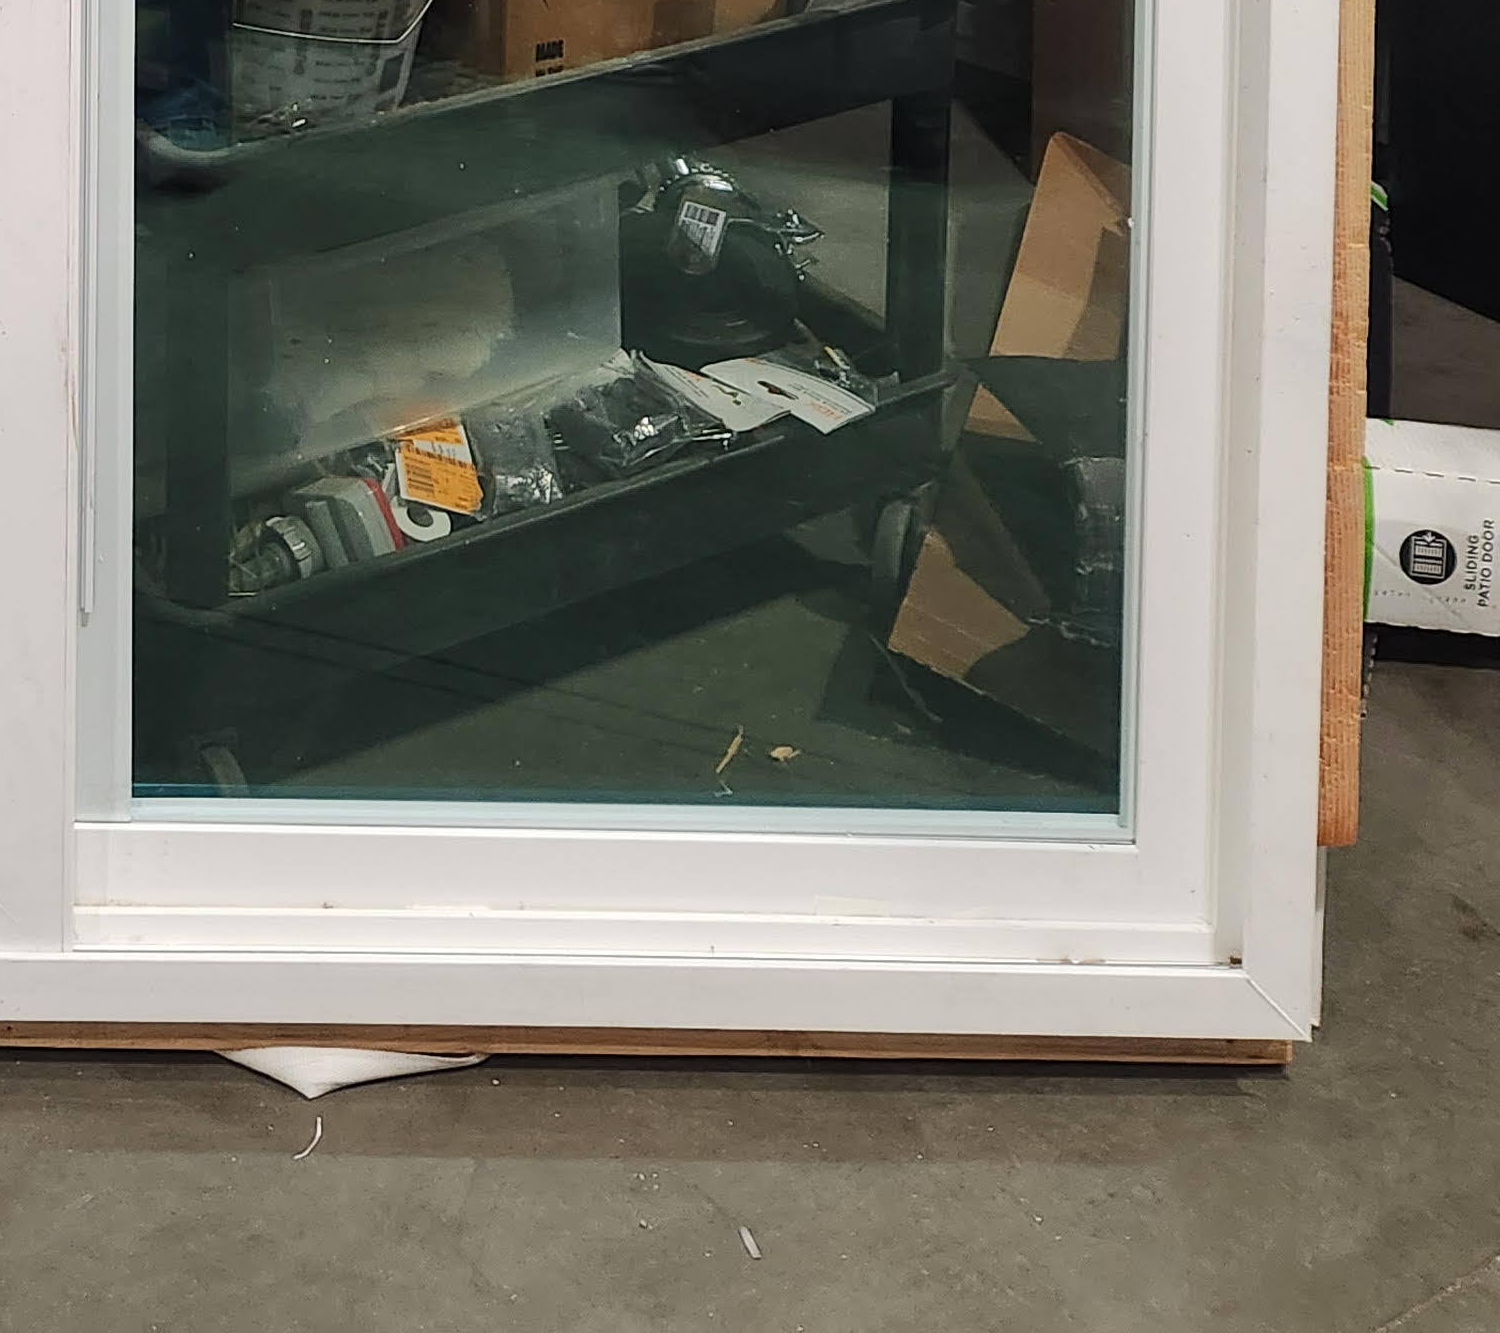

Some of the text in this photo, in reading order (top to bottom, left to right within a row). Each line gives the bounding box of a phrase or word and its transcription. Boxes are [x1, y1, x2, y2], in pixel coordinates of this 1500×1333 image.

[1464, 534, 1480, 591] SLIDING
[1477, 519, 1495, 608] PATIO DOOR
